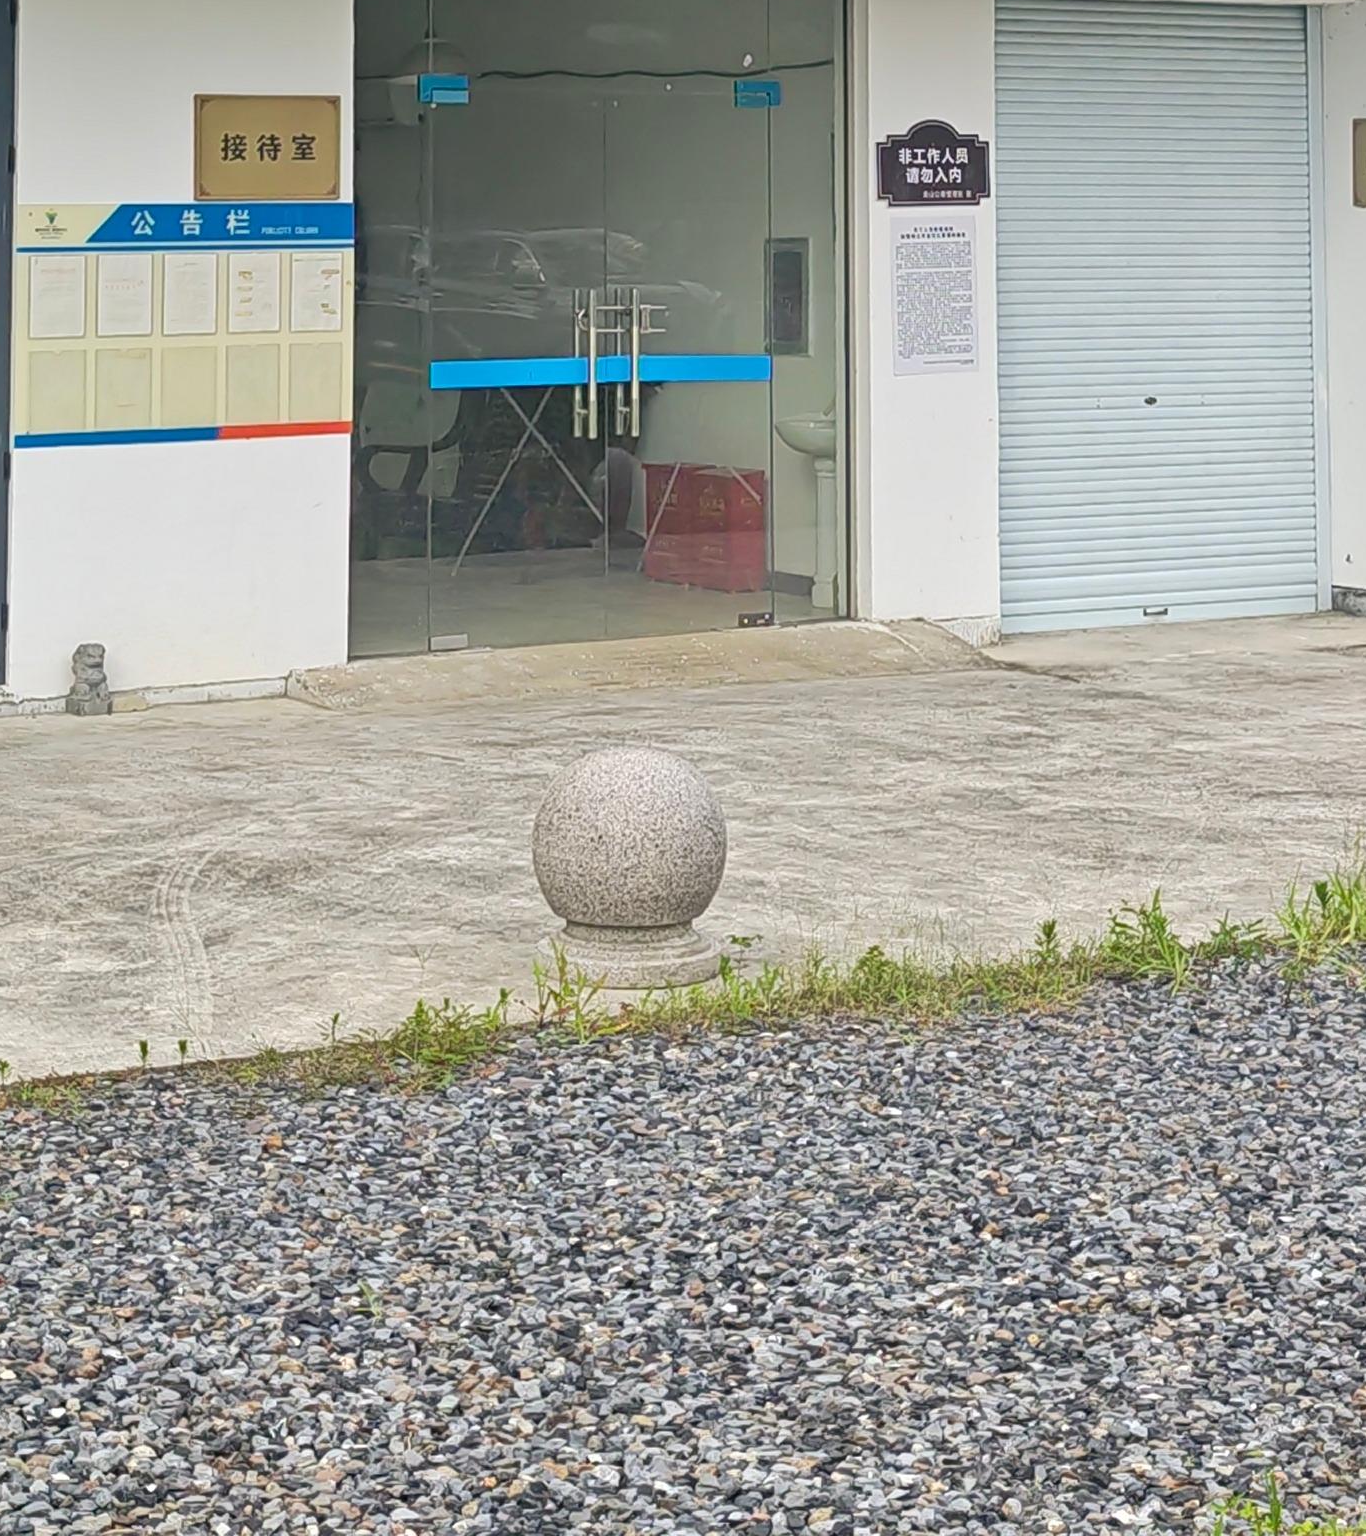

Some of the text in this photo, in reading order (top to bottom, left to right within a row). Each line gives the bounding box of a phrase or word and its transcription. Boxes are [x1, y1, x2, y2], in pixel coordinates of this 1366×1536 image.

[221, 133, 317, 162] 接待室
[898, 147, 969, 164] 非工作人员
[906, 167, 962, 184] 请勿入内
[131, 209, 251, 236] 公告栏
